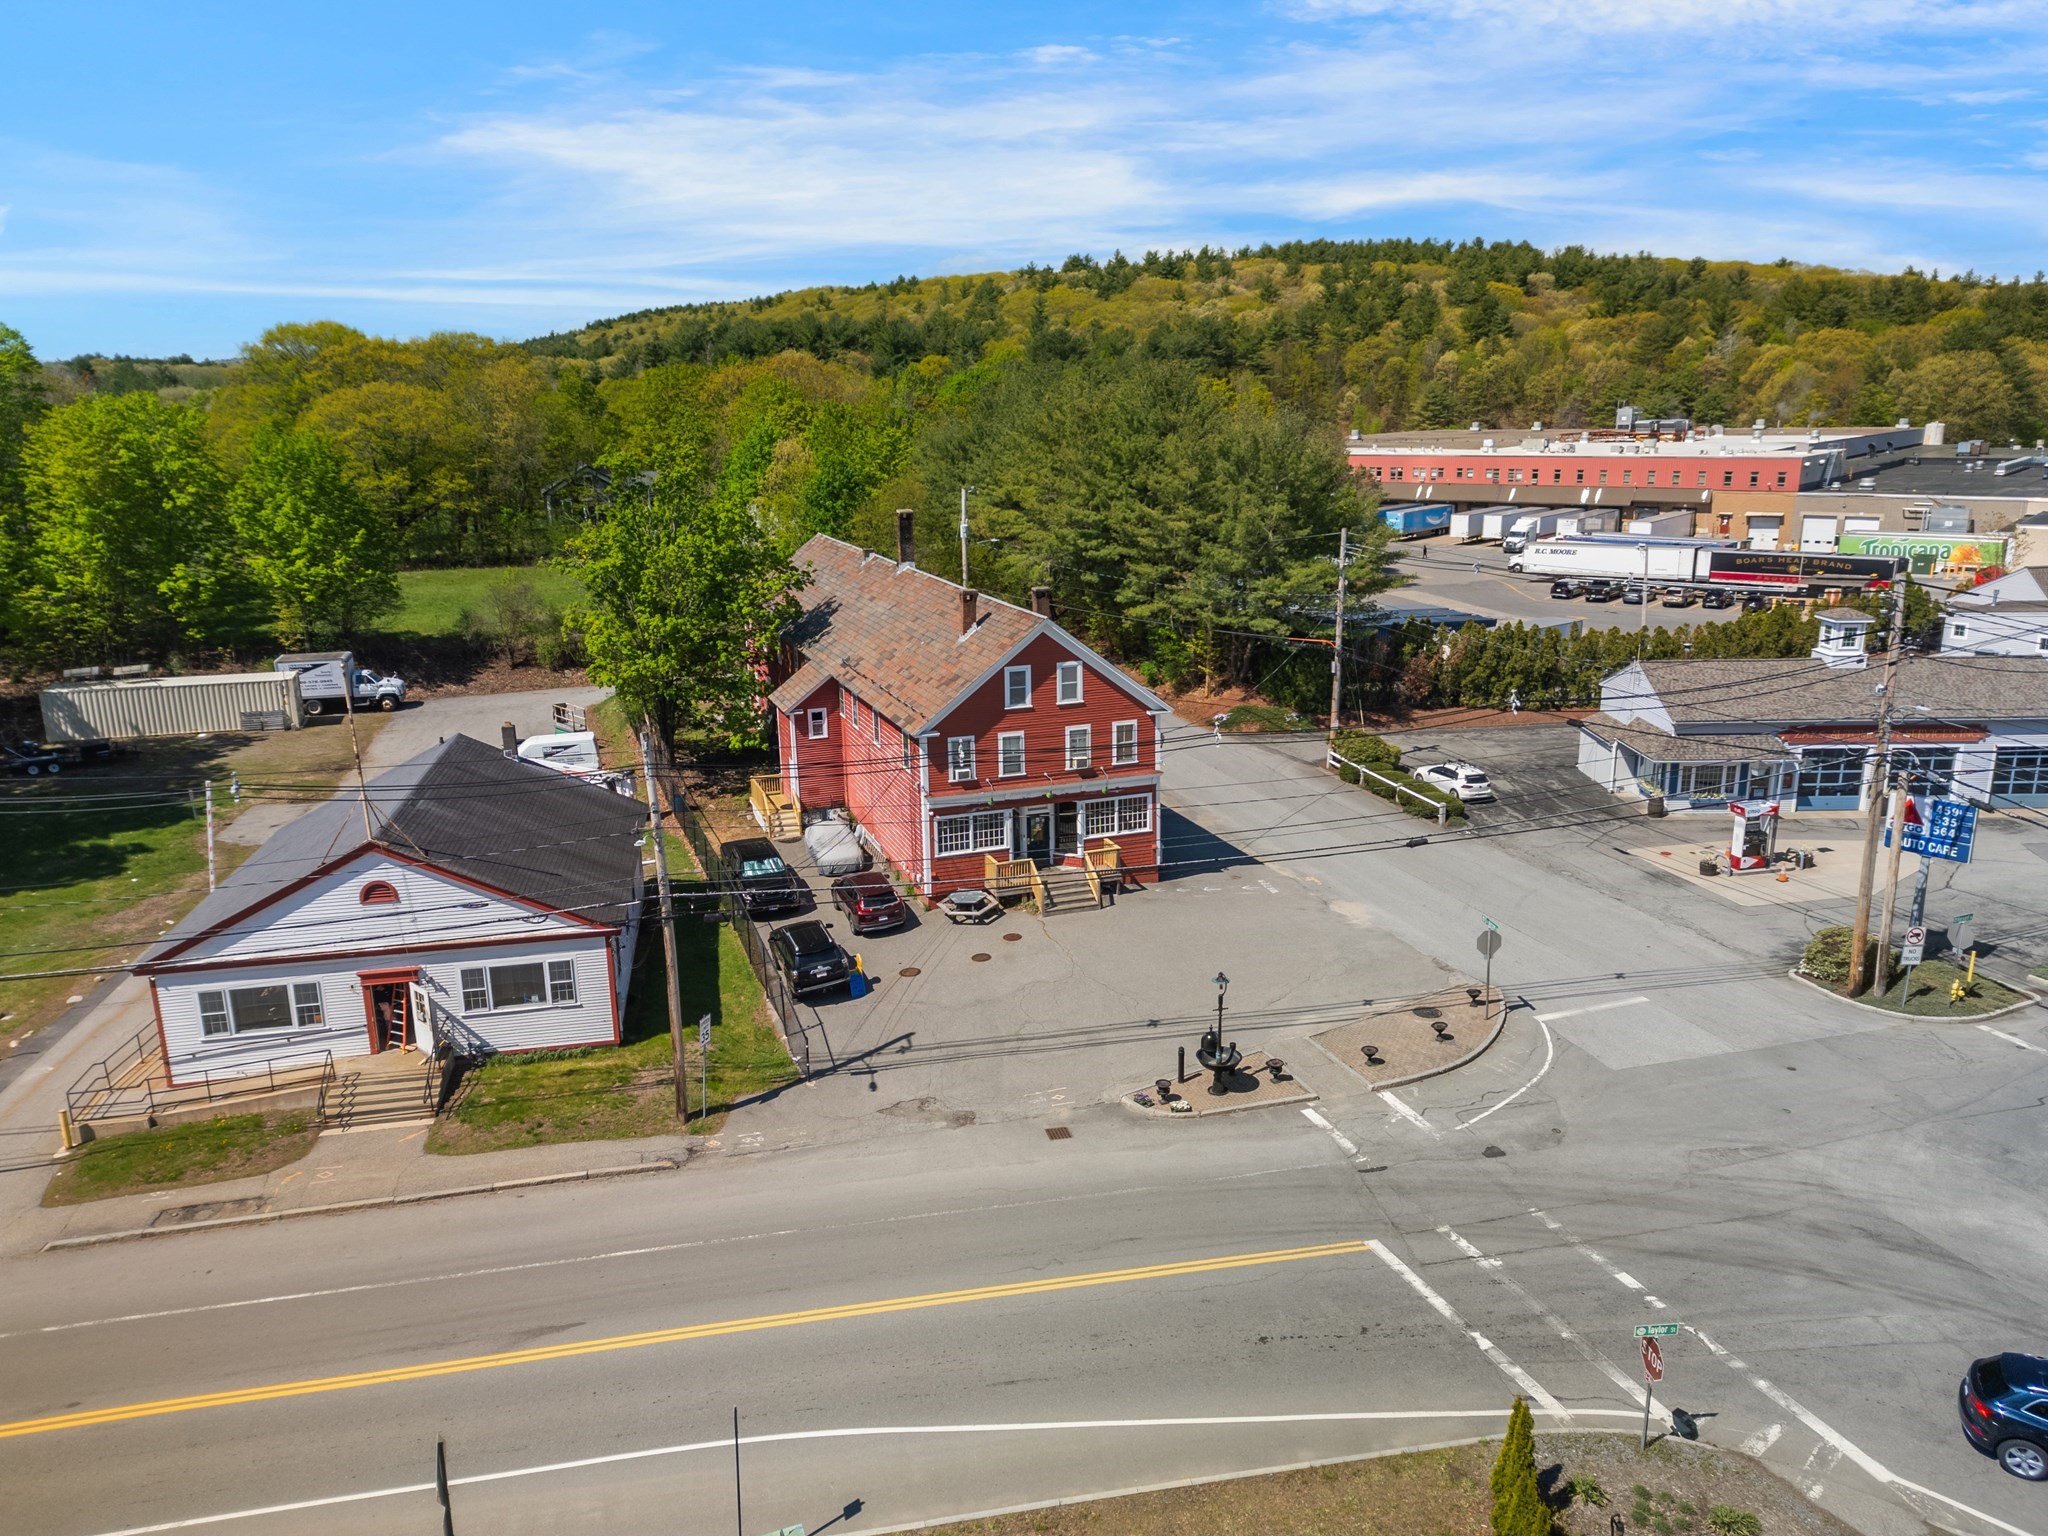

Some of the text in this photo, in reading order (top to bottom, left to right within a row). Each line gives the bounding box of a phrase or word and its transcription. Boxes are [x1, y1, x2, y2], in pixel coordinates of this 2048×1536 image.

[1860, 537, 1952, 560] Tropicana
[1735, 555, 1852, 571] BOAR'S HEAD BRAND
[1890, 821, 1923, 833] CTGO
[1934, 815, 1957, 828] 535
[1932, 825, 1956, 838] 564
[1900, 837, 1958, 858] UTO CARE
[702, 1029, 710, 1043] 35
[1648, 1326, 1668, 1335] Taylor
[1641, 1339, 1663, 1373] STOP
